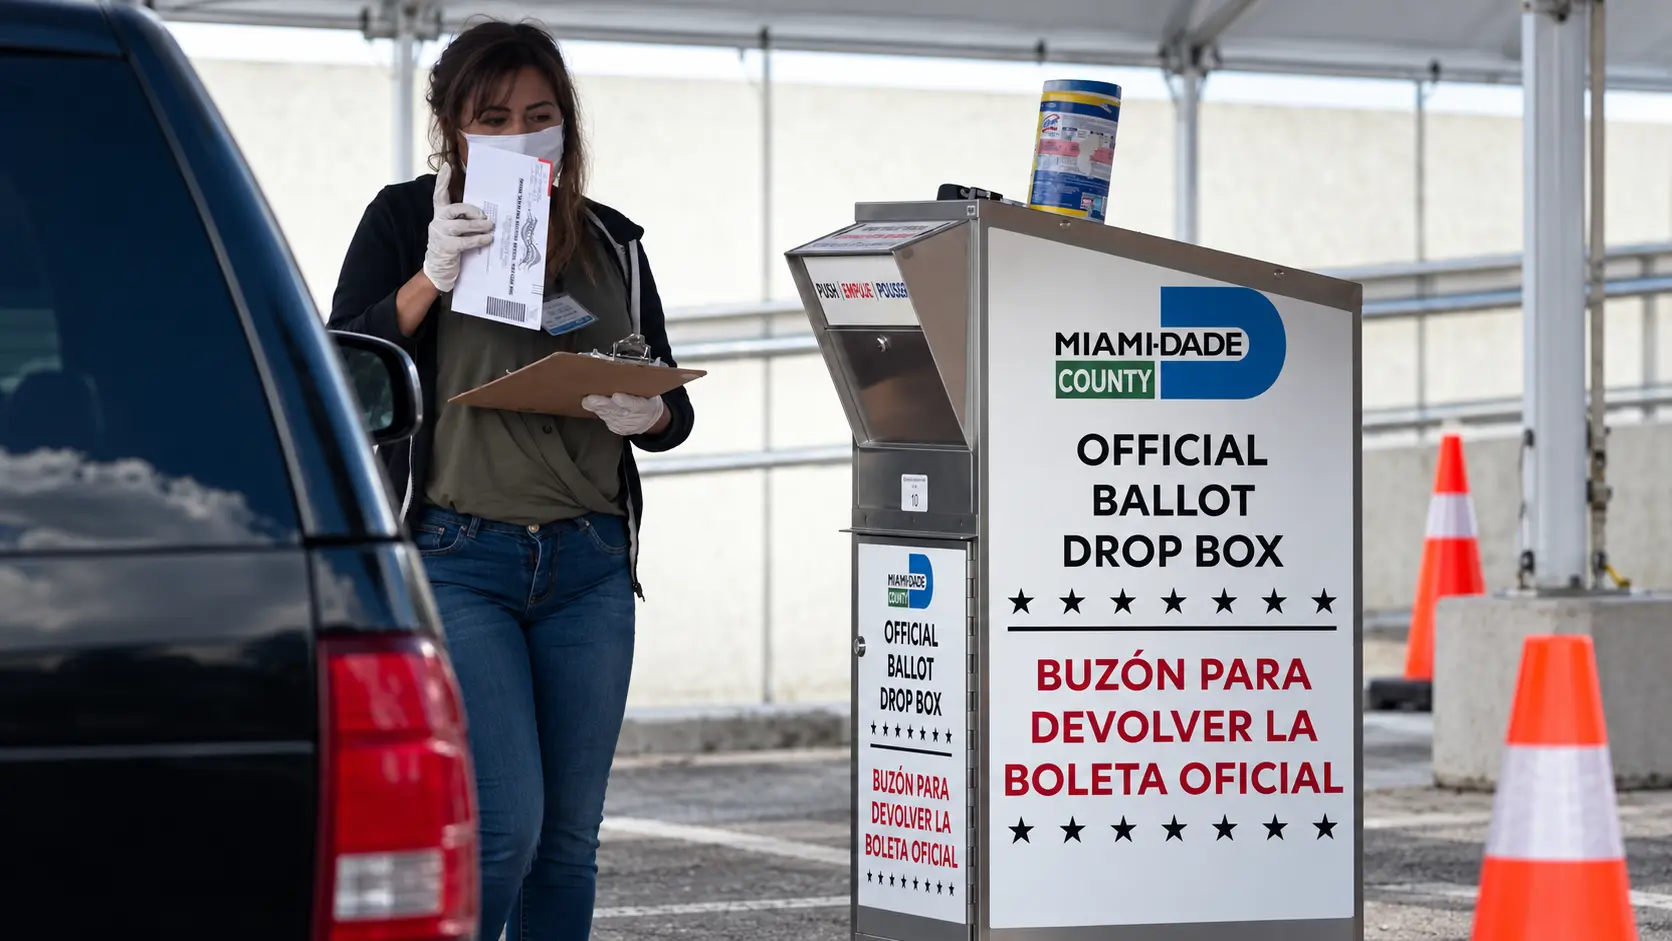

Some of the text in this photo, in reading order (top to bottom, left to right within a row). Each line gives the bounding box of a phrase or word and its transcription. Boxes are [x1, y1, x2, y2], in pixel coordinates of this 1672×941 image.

[815, 282, 840, 299] PUSH
[1055, 332, 1242, 356] MIAMI-DADE
[1058, 368, 1152, 393] COUNTY
[1076, 433, 1268, 466] OFFICIAL
[1093, 484, 1255, 516] BALLOT
[1063, 534, 1284, 567] DROP BOX
[888, 574, 925, 588] MIAMI-DADE
[889, 592, 908, 605] COUNTY
[884, 620, 938, 647] OFFICIAL
[888, 654, 934, 681] BALLOT
[1037, 649, 1312, 691] BUZÓN PARA
[880, 687, 942, 716] DROP BOX
[1031, 710, 1318, 743] DEVOLVER LA
[873, 766, 949, 800] BUZÓN PARA
[1004, 762, 1343, 796] BOLETA OFICIAL
[872, 801, 951, 834] DEVOLVER LA
[865, 833, 958, 868] BOLETA OFICIAL
